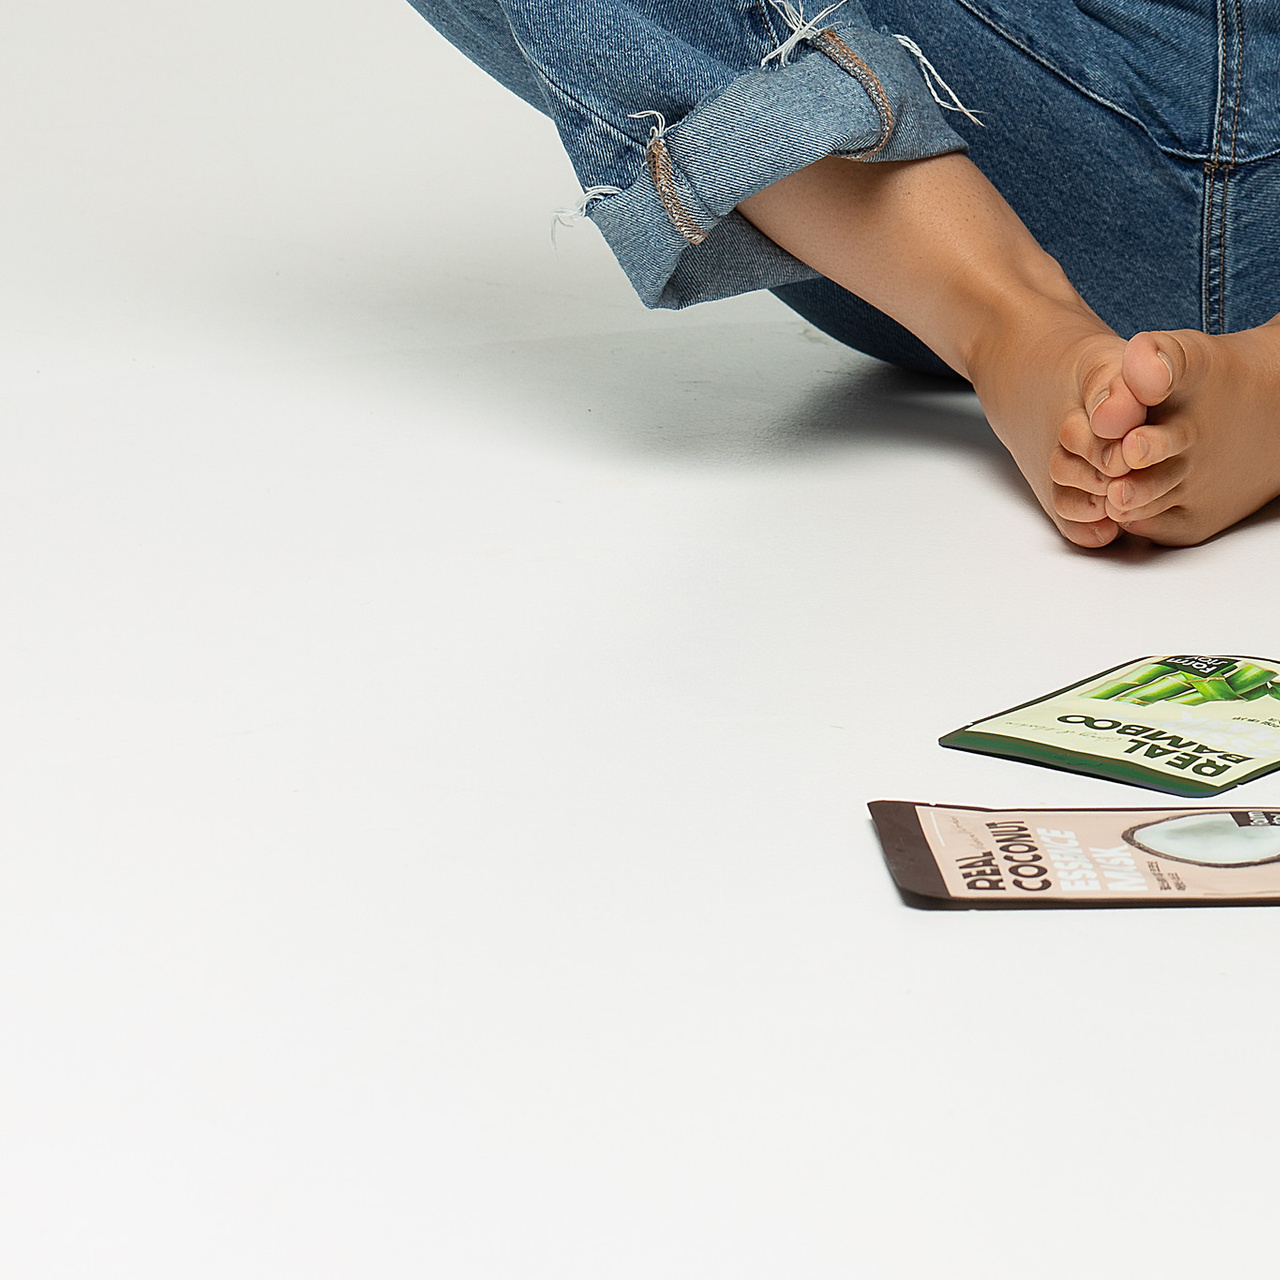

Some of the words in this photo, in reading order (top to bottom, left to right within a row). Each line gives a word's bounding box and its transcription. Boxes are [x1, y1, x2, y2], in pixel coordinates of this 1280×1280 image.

[1166, 658, 1217, 673] Farm
[1056, 714, 1255, 764] BAMBOO
[1123, 739, 1231, 777] REAL
[955, 850, 1006, 891] REAL
[985, 820, 1052, 891] COCONUT
[1036, 827, 1102, 891] ESSENCE
[1089, 844, 1149, 891] MASK
